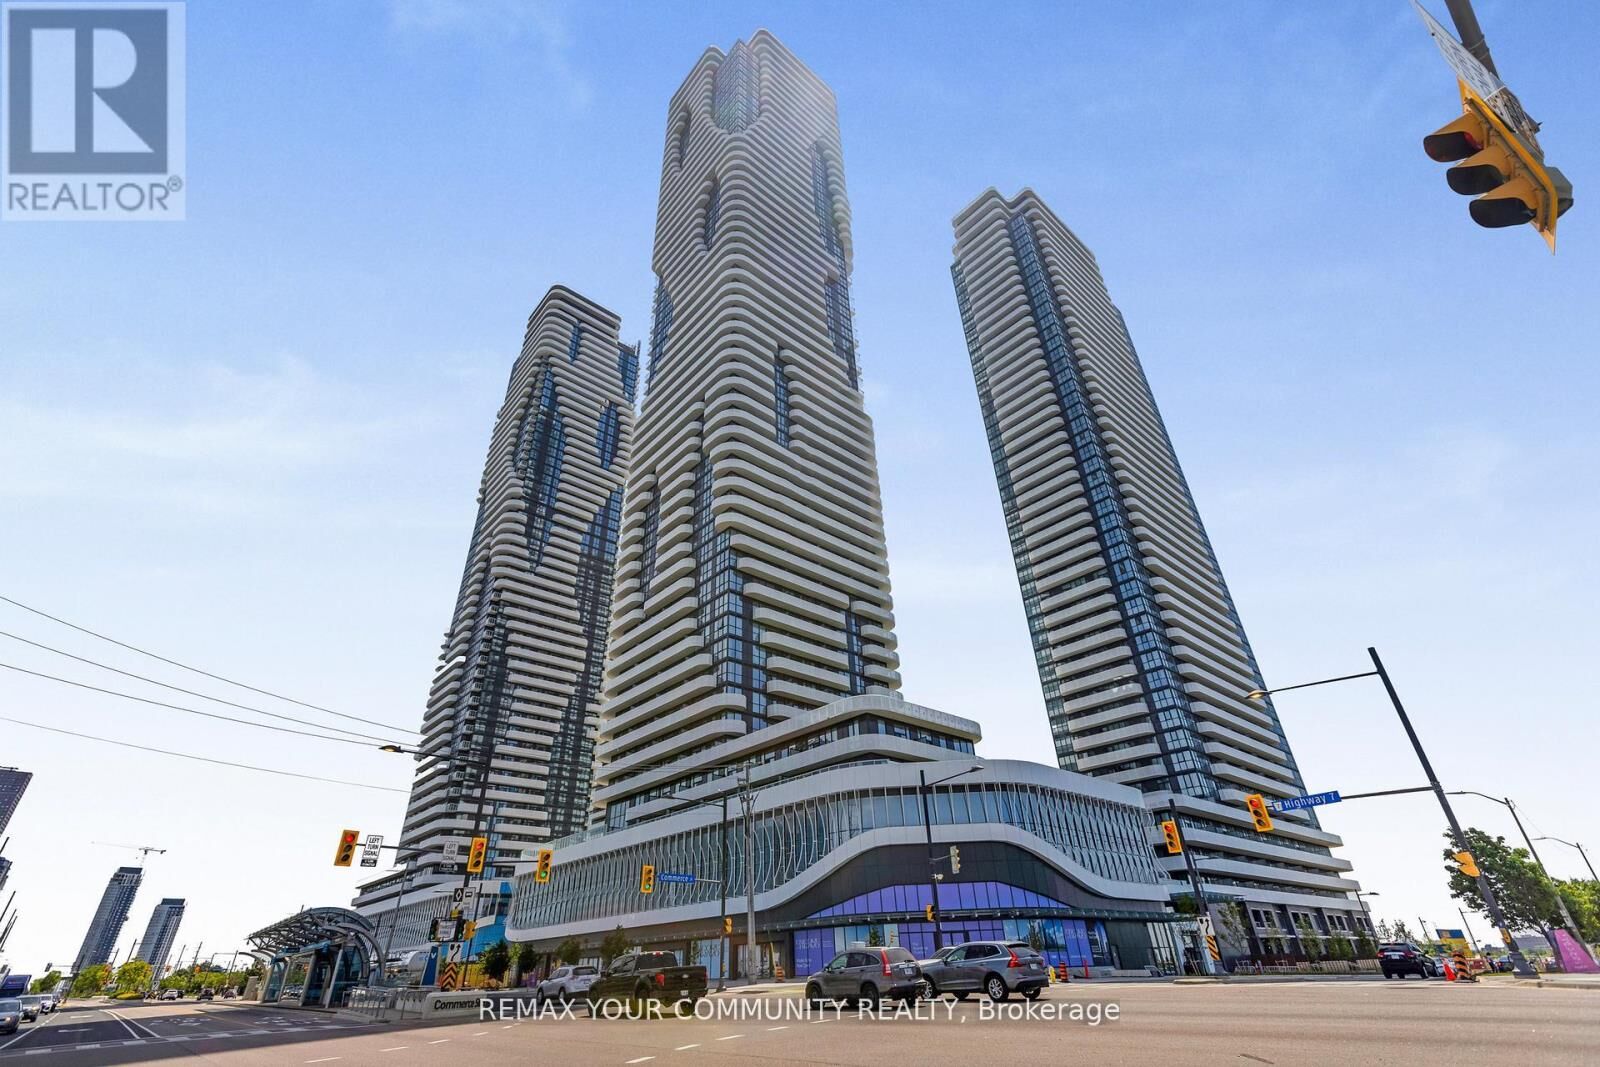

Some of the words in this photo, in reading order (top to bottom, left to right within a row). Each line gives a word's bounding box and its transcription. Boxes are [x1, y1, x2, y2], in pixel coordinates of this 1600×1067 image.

[1283, 795, 1326, 809] Highway
[1329, 792, 1335, 801] 7
[660, 874, 689, 882] Commerce
[434, 999, 474, 1010] Commerce
